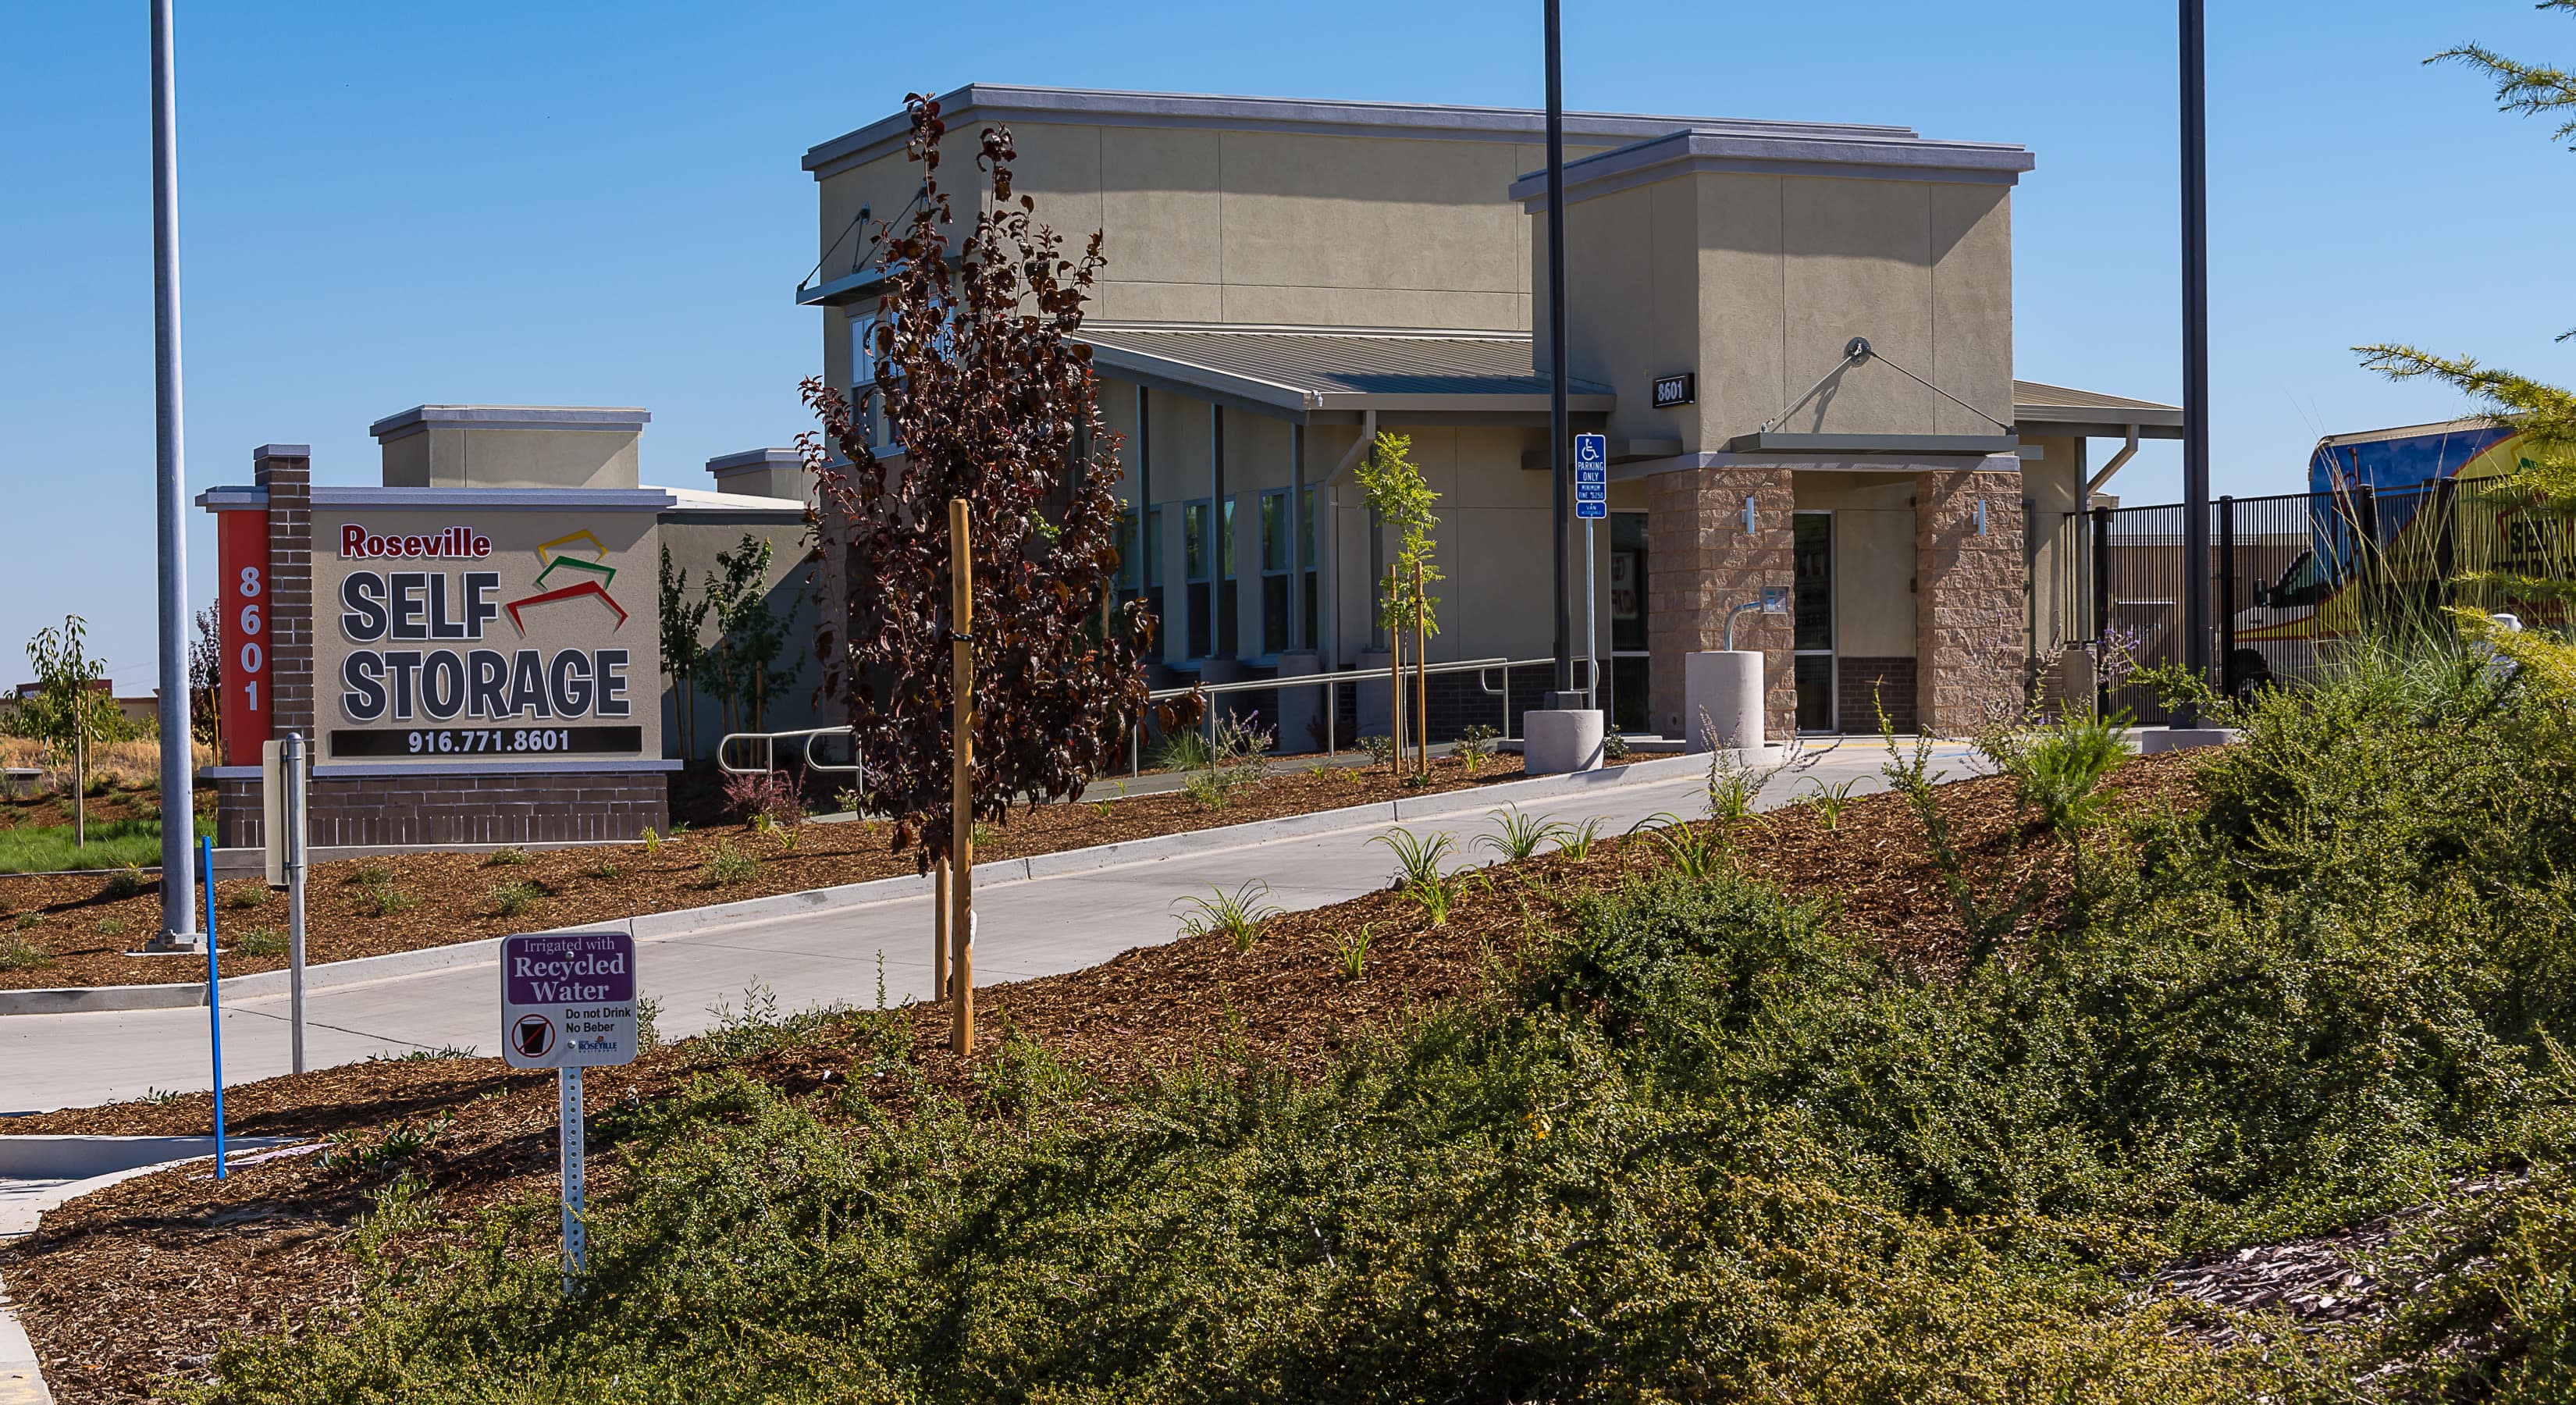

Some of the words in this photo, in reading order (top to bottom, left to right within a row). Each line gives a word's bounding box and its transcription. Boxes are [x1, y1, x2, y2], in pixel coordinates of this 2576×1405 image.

[1657, 380, 1683, 401] 8601
[1578, 461, 1603, 471] PARKING
[1583, 472, 1599, 481] ONLY
[340, 524, 492, 560] Roseville
[342, 571, 501, 642] SELF
[239, 566, 263, 712] 8601
[342, 648, 632, 720] STORAGE
[409, 730, 569, 754] 916.771.8601
[524, 937, 582, 955] Irrigated
[586, 937, 614, 950] with
[514, 952, 625, 981] Recycled
[530, 980, 610, 1002] Water
[565, 1008, 581, 1019] Do
[583, 1008, 600, 1019] not
[603, 1007, 631, 1018] Drink
[566, 1023, 581, 1033] No
[583, 1022, 615, 1033] Beber
[578, 1041, 617, 1050] ROSEVILLE
